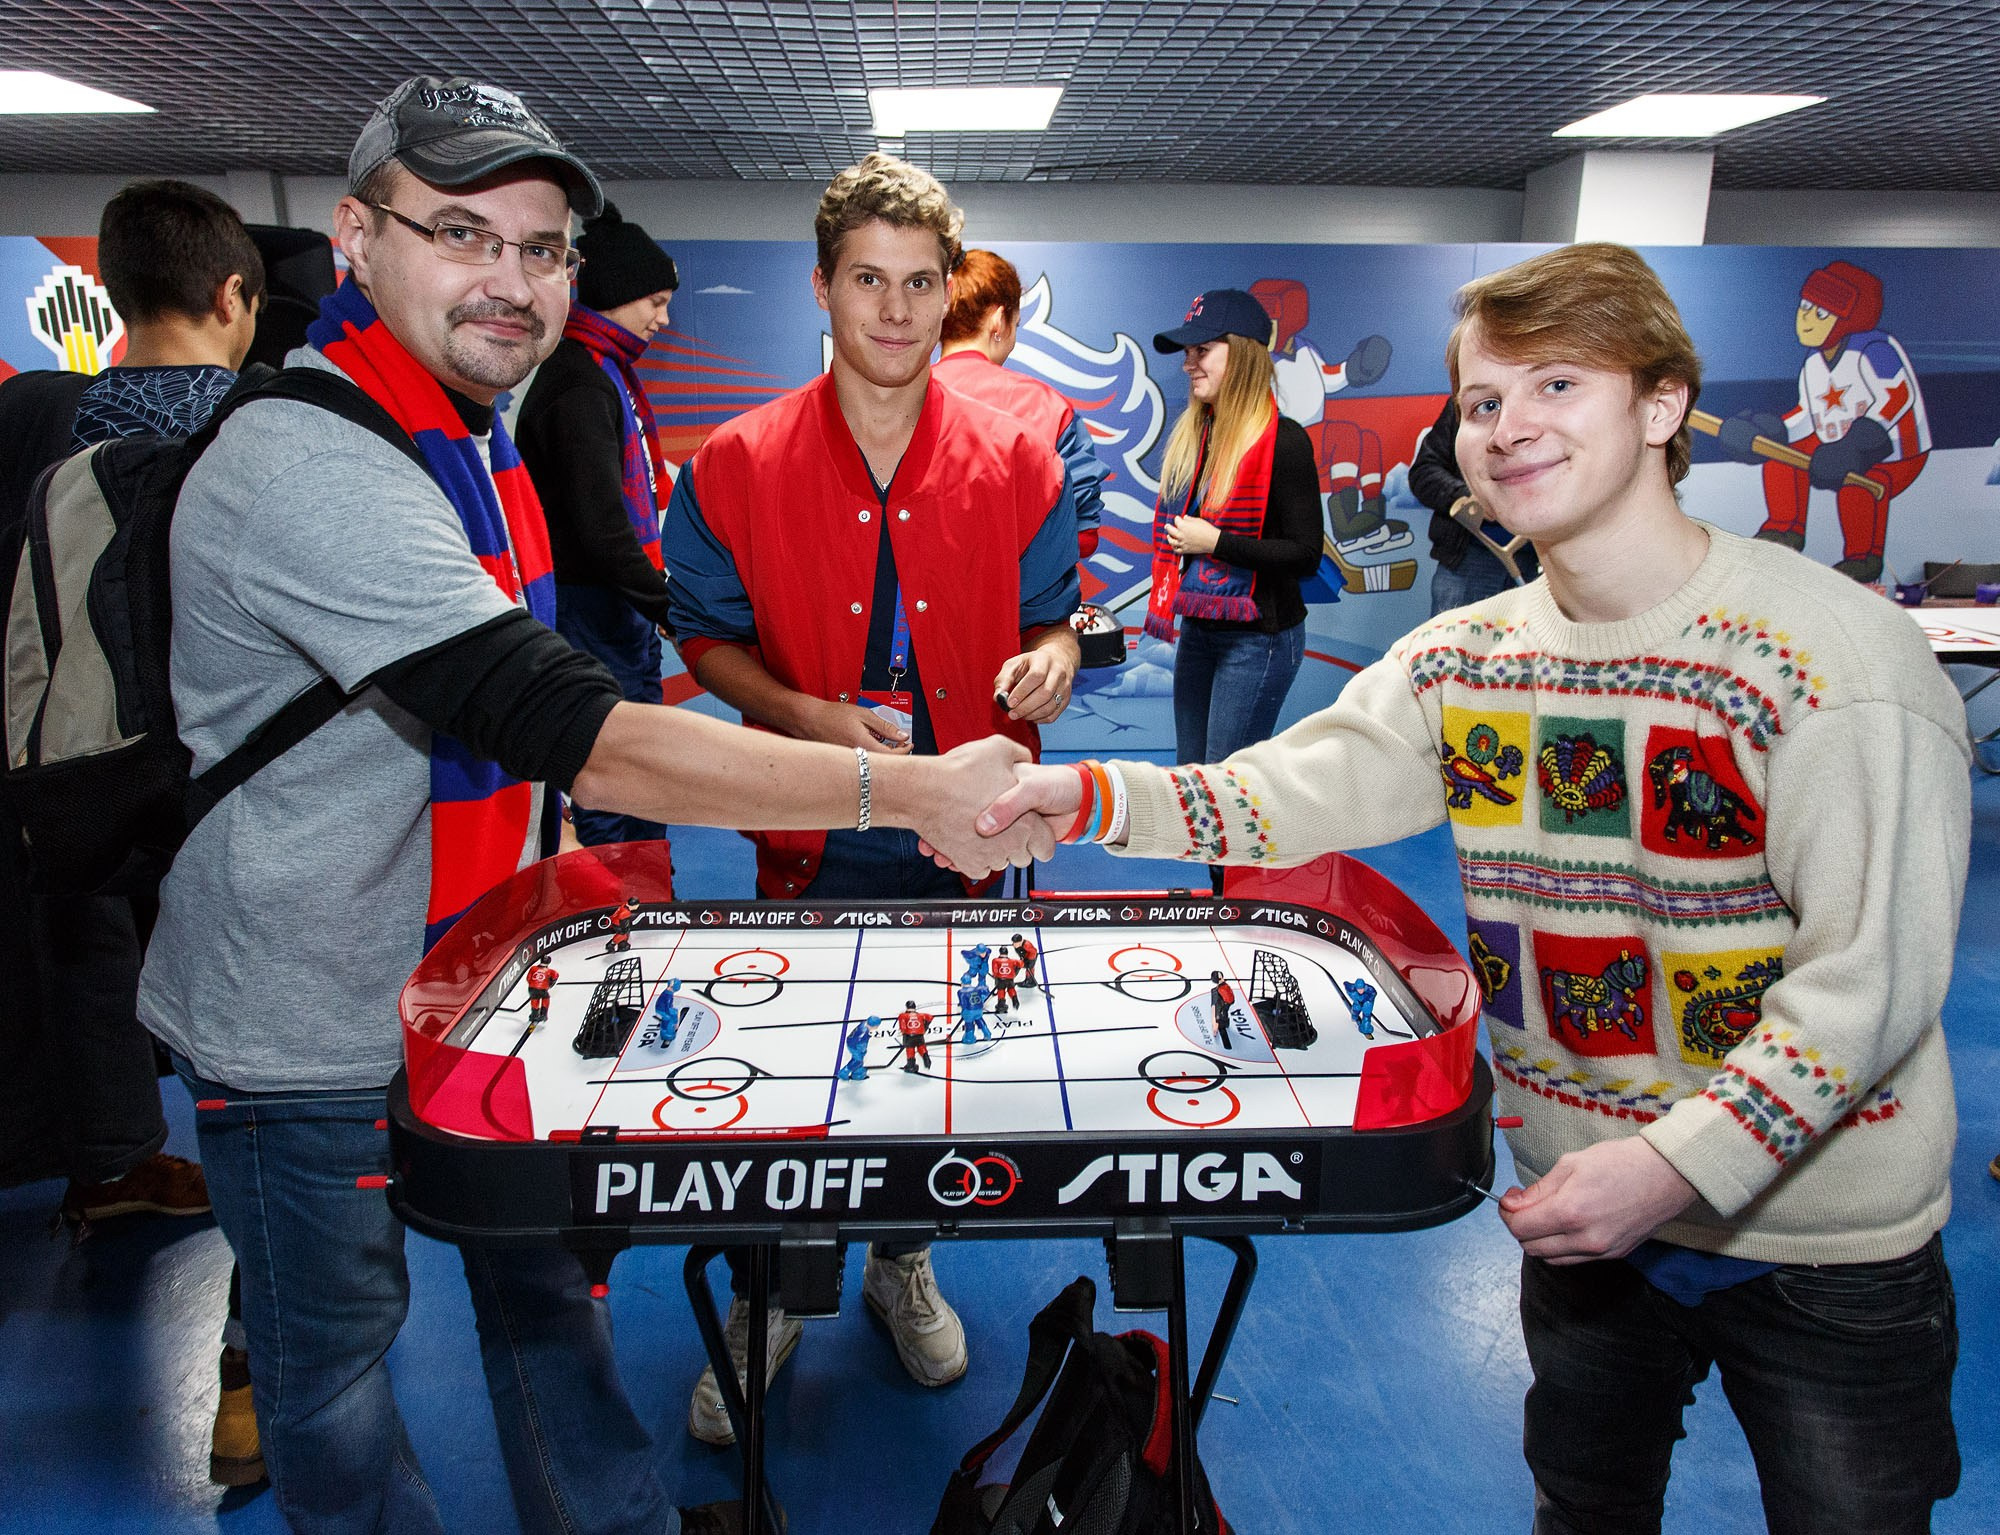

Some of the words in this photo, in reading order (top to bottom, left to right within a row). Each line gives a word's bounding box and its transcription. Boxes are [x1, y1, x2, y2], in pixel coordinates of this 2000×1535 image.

[632, 911, 691, 926] STIGA
[729, 911, 764, 925] PLAY
[766, 911, 796, 925] OFF
[833, 912, 892, 926] STIGA
[951, 909, 988, 923] PLAY
[989, 908, 1018, 923] OFF
[1053, 908, 1112, 922] STIGA
[1148, 907, 1184, 921] PLAY
[1185, 906, 1215, 920] OFF
[1251, 908, 1308, 929] STIGA
[536, 927, 565, 953] PLAY
[565, 919, 593, 939] OFF
[1340, 928, 1363, 953] PLAY
[1362, 945, 1374, 964] OFF
[498, 960, 521, 998] STIGA
[993, 1019, 1034, 1030] PLAY
[595, 1159, 752, 1214] PLAY
[760, 1157, 888, 1212] OFF
